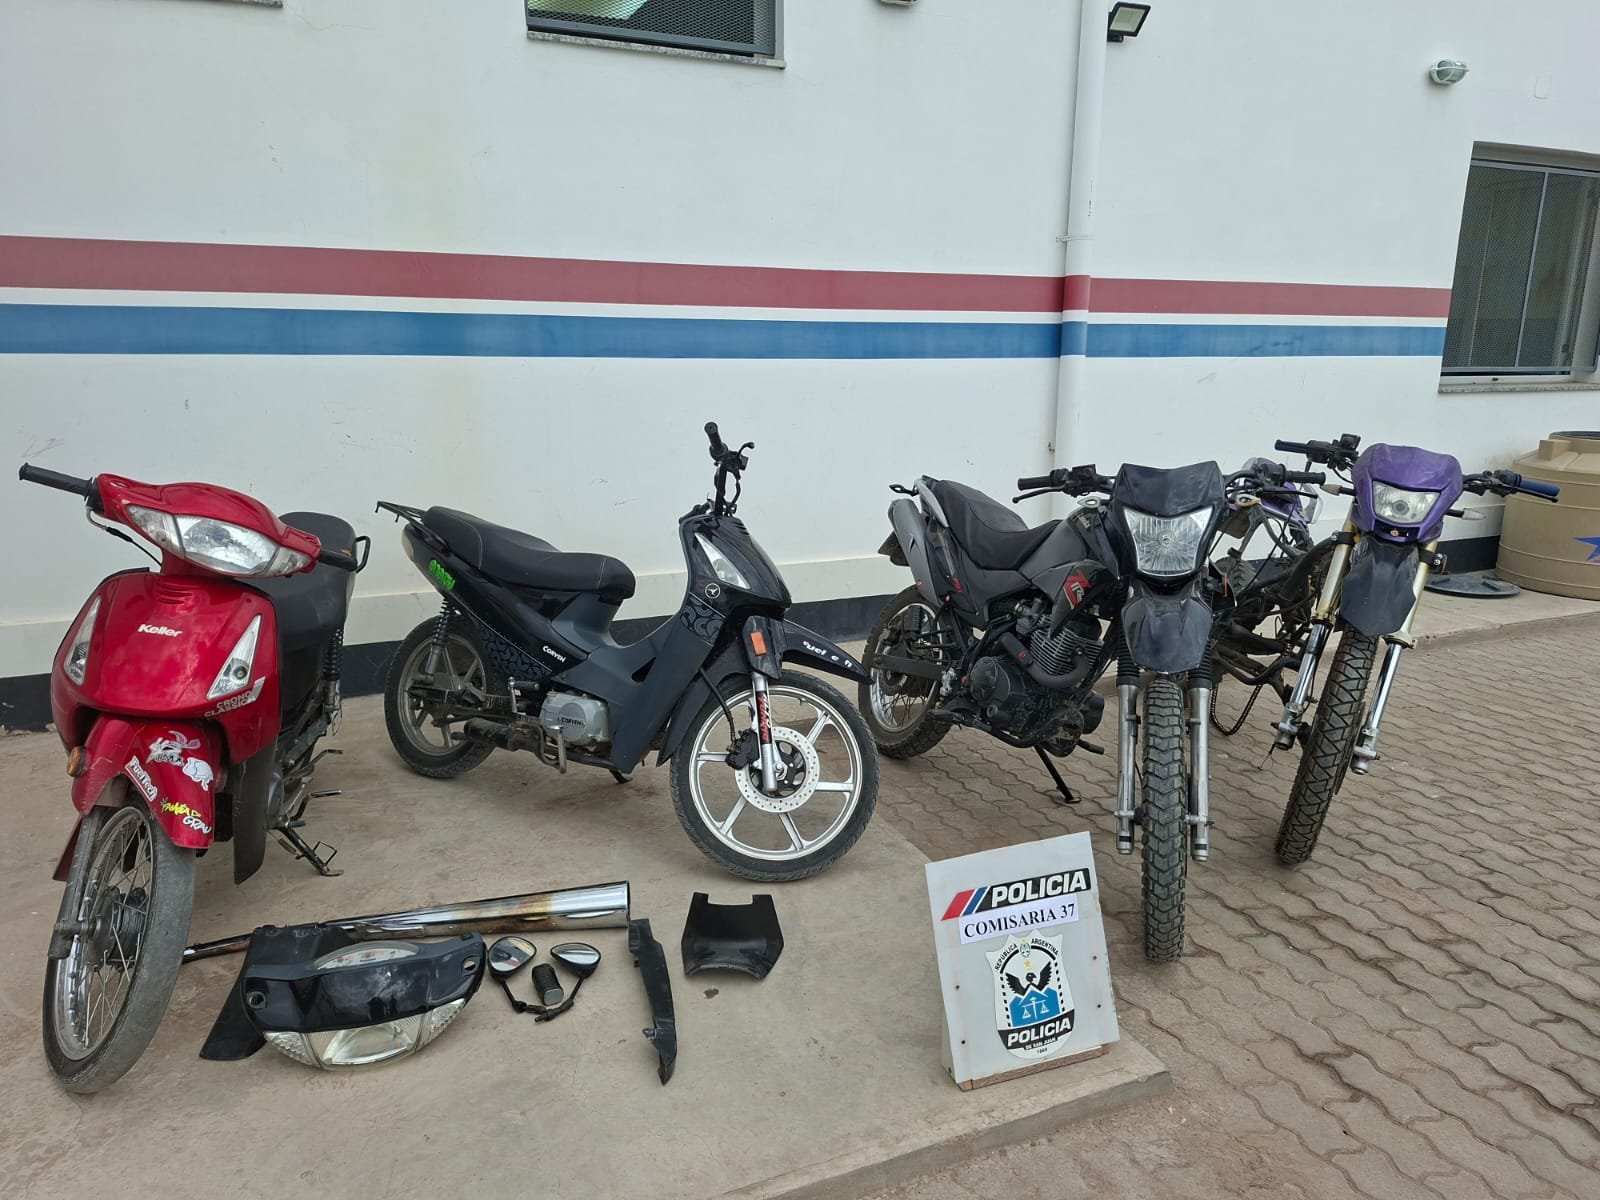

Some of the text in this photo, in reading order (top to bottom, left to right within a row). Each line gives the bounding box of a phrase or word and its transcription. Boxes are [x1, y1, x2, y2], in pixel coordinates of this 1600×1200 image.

[137, 623, 183, 638] Keller
[204, 698, 252, 718] CLASSIC
[216, 690, 252, 709] CRONO
[991, 870, 1087, 908] POLICIA
[964, 903, 1075, 938] COMISARIA 37
[1031, 938, 1059, 956] ARGENTINA
[1007, 1017, 1072, 1047] POLICIA
